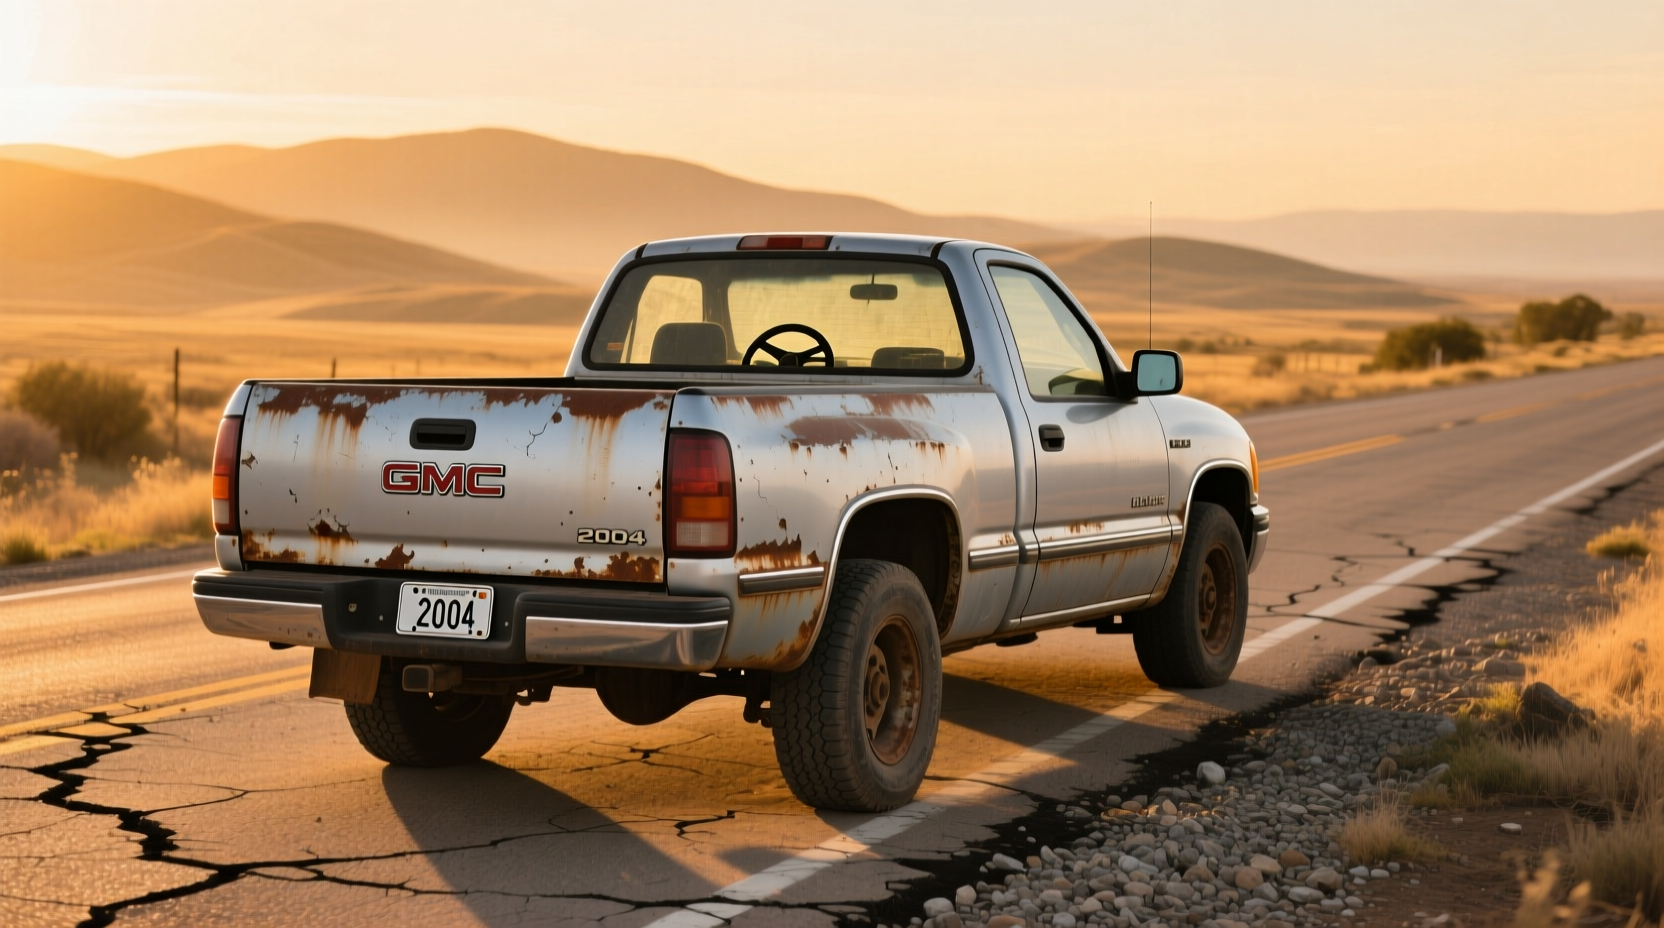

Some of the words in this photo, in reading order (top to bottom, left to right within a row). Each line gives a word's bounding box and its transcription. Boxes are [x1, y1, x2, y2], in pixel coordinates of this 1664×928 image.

[381, 461, 505, 498] GMC
[577, 527, 646, 545] 2004
[416, 597, 475, 630] 2004
